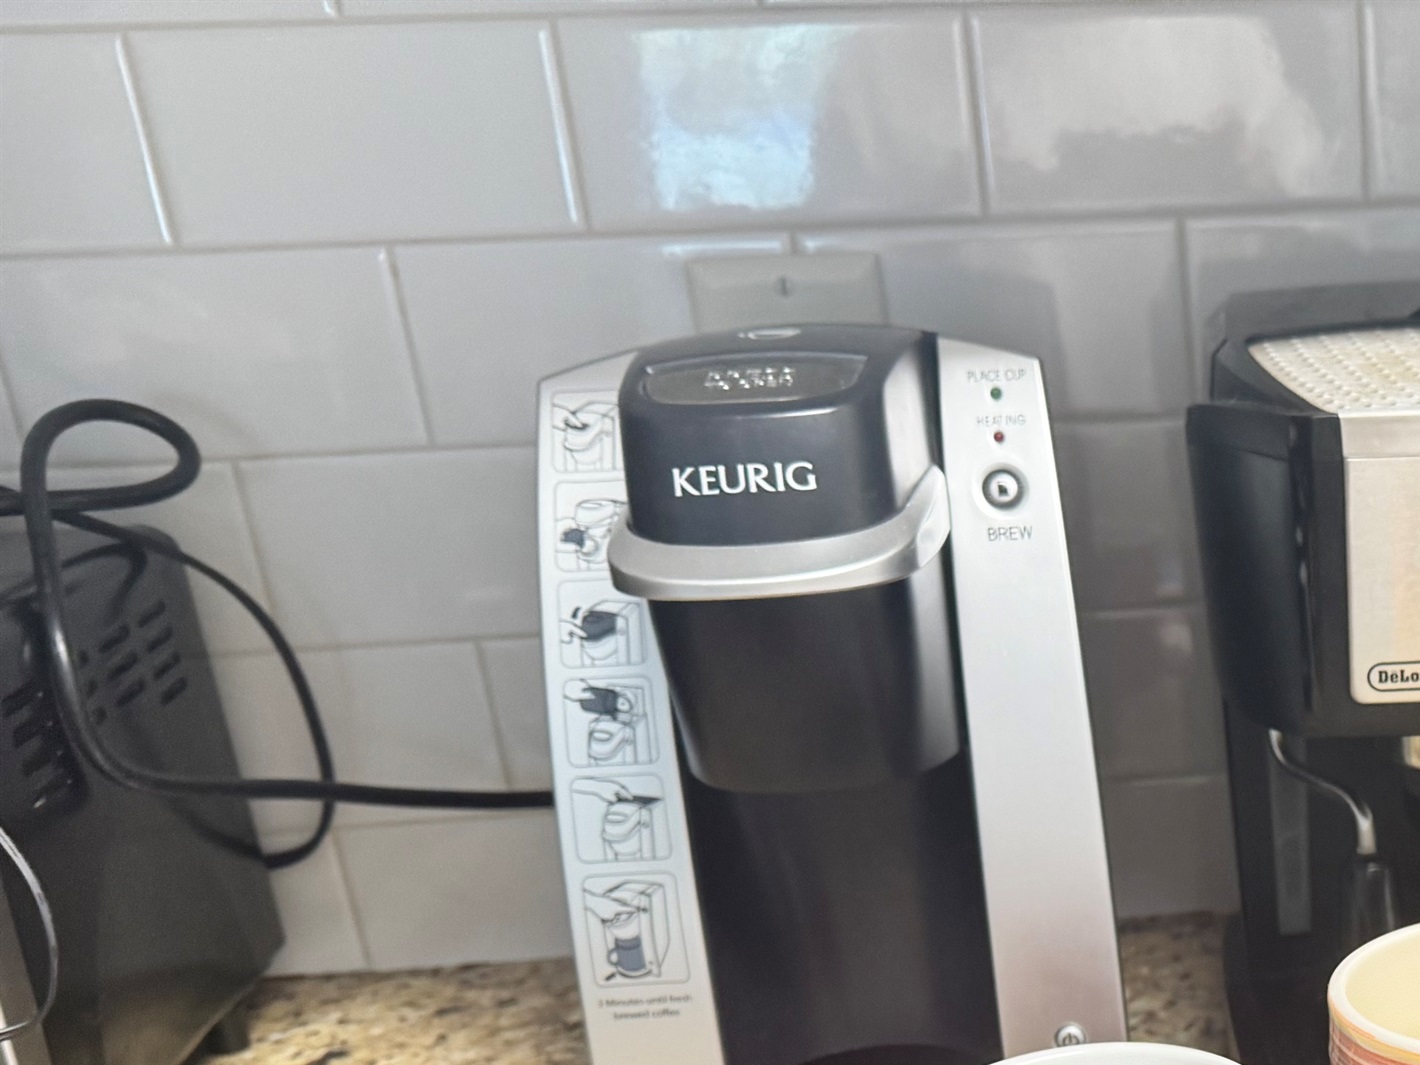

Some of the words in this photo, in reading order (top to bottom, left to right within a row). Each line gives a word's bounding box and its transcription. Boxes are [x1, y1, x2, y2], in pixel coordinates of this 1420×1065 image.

[966, 369, 1000, 383] PLACE
[1004, 368, 1027, 382] CUP
[976, 414, 1027, 428] HEATING
[671, 460, 818, 498] KEURIG
[987, 525, 1033, 542] BREW
